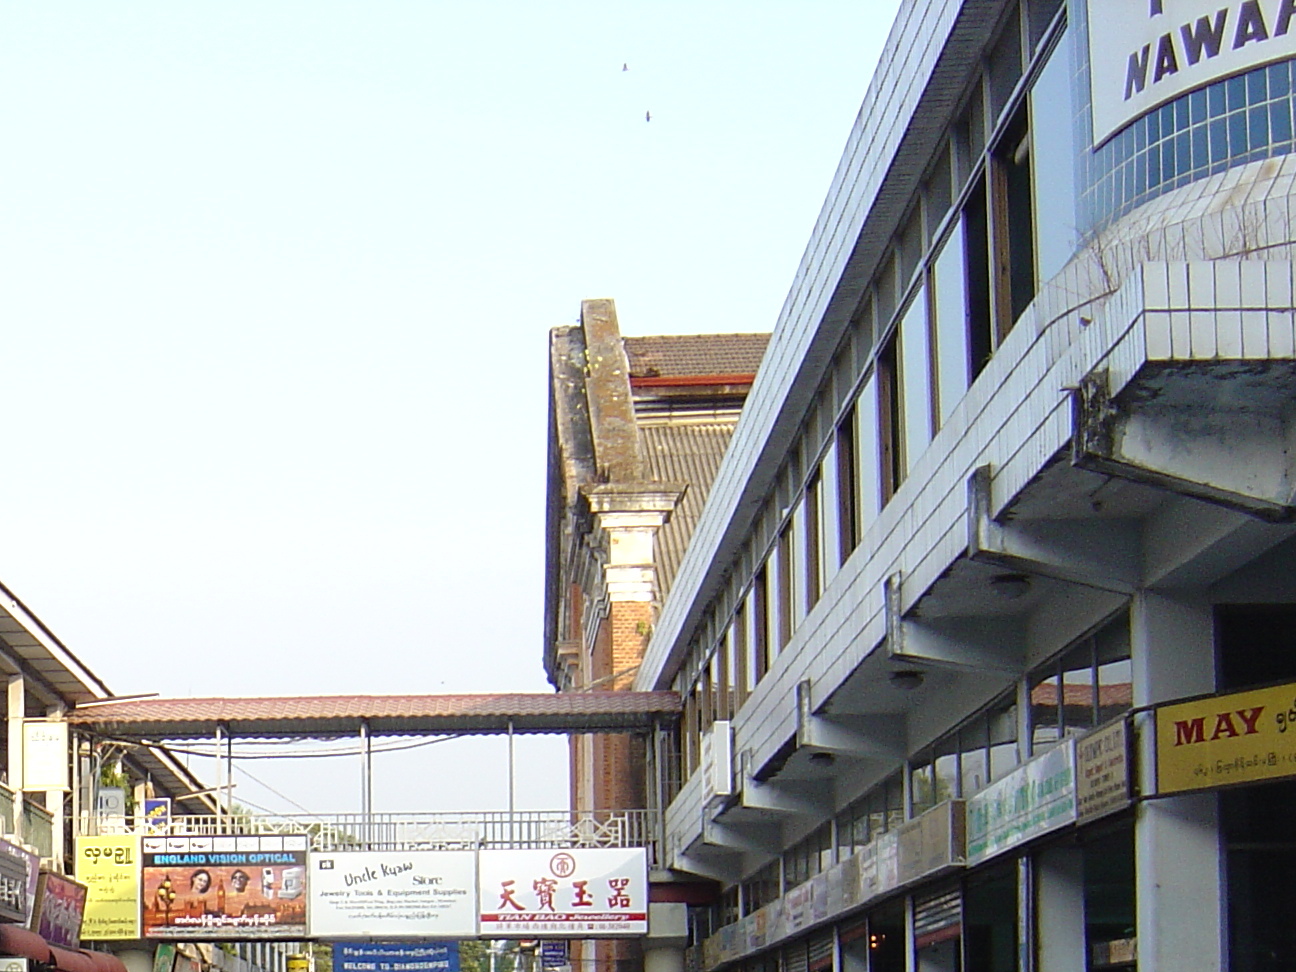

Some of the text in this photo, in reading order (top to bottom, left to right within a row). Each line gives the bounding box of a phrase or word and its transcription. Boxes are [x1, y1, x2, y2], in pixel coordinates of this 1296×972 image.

[1173, 706, 1266, 747] MAY
[154, 853, 296, 864] ENGLAND VISION OPTICAL
[344, 861, 413, 887] Uncle Kyaw
[412, 875, 443, 886] Store
[387, 889, 430, 898] Equipment
[433, 888, 467, 897] Supplies
[498, 877, 631, 912] 天寶玉器
[497, 913, 531, 921] TIAN
